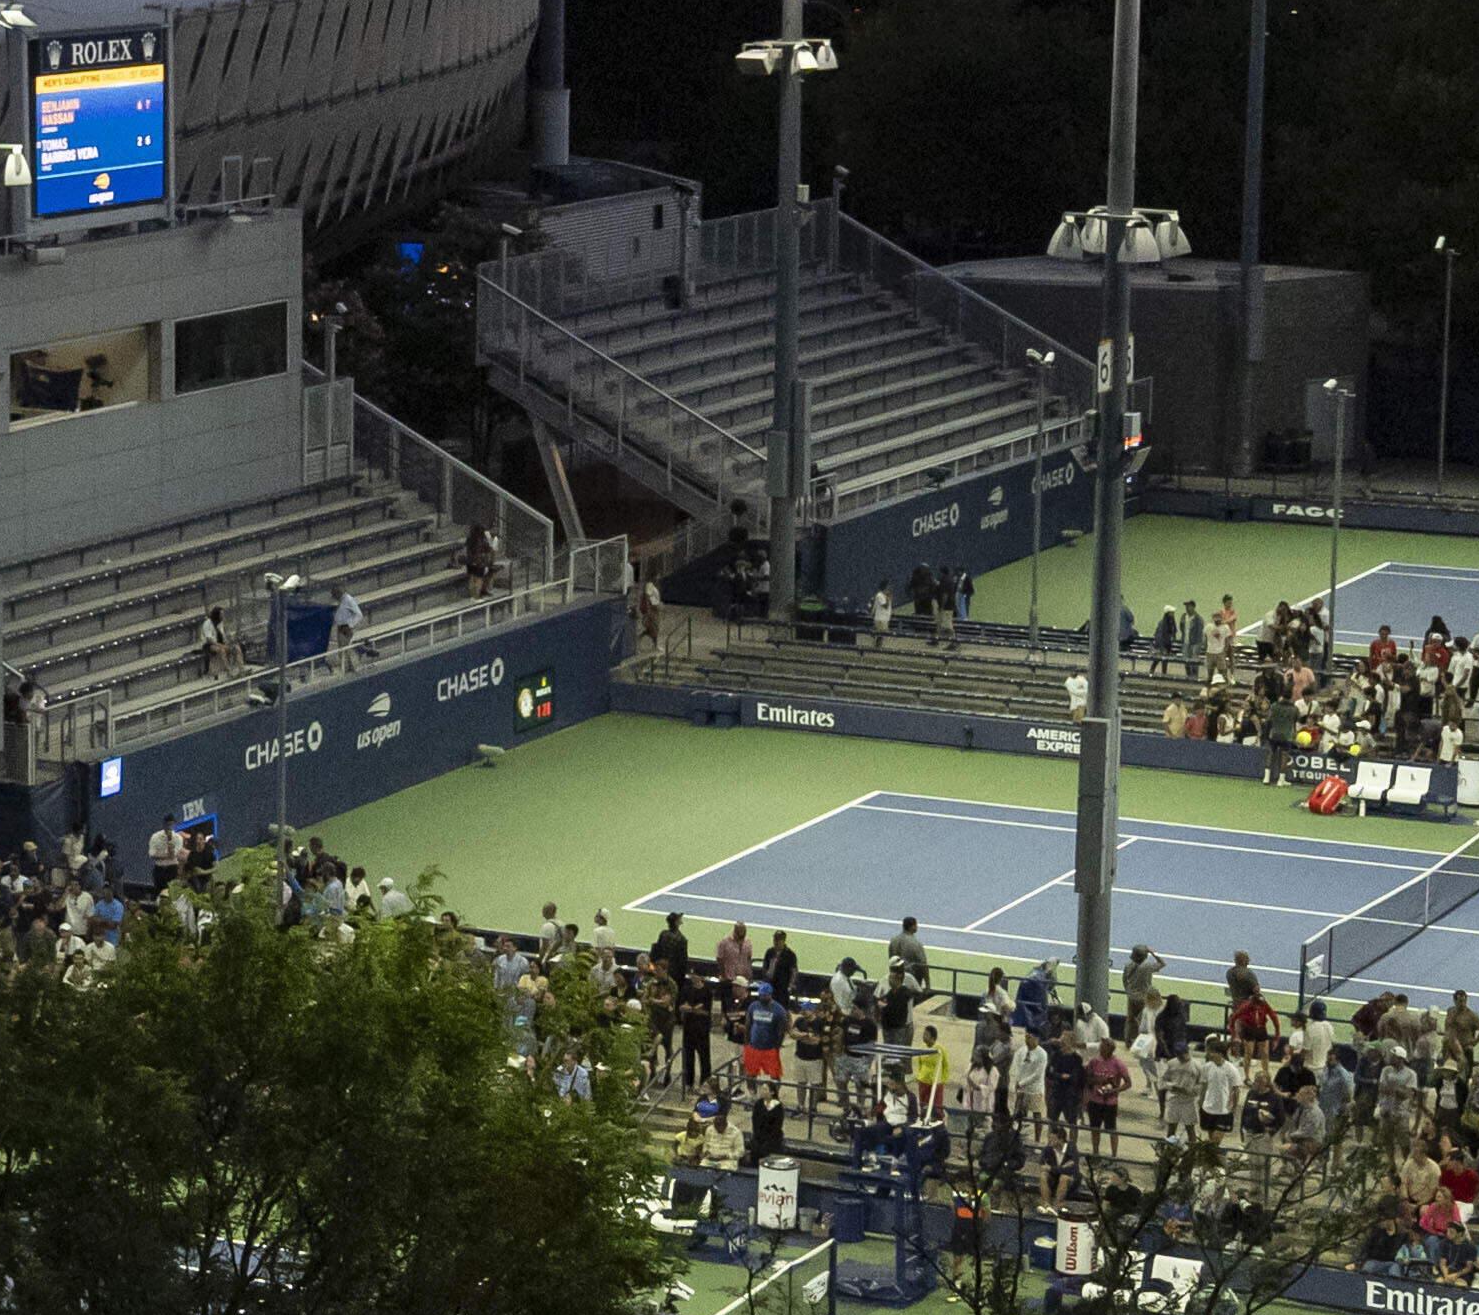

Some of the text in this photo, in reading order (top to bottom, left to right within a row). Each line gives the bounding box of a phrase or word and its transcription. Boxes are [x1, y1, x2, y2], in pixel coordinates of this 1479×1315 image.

[71, 39, 133, 66] ROLEX
[912, 507, 949, 538] CHASE
[436, 664, 490, 703] CHASE
[756, 702, 835, 727] Emirates
[1026, 727, 1081, 742] AMERIC
[1036, 739, 1081, 755] EXPRE
[244, 728, 306, 771] CHASE
[182, 798, 206, 822] IBM
[1064, 1226, 1079, 1271] Wilson
